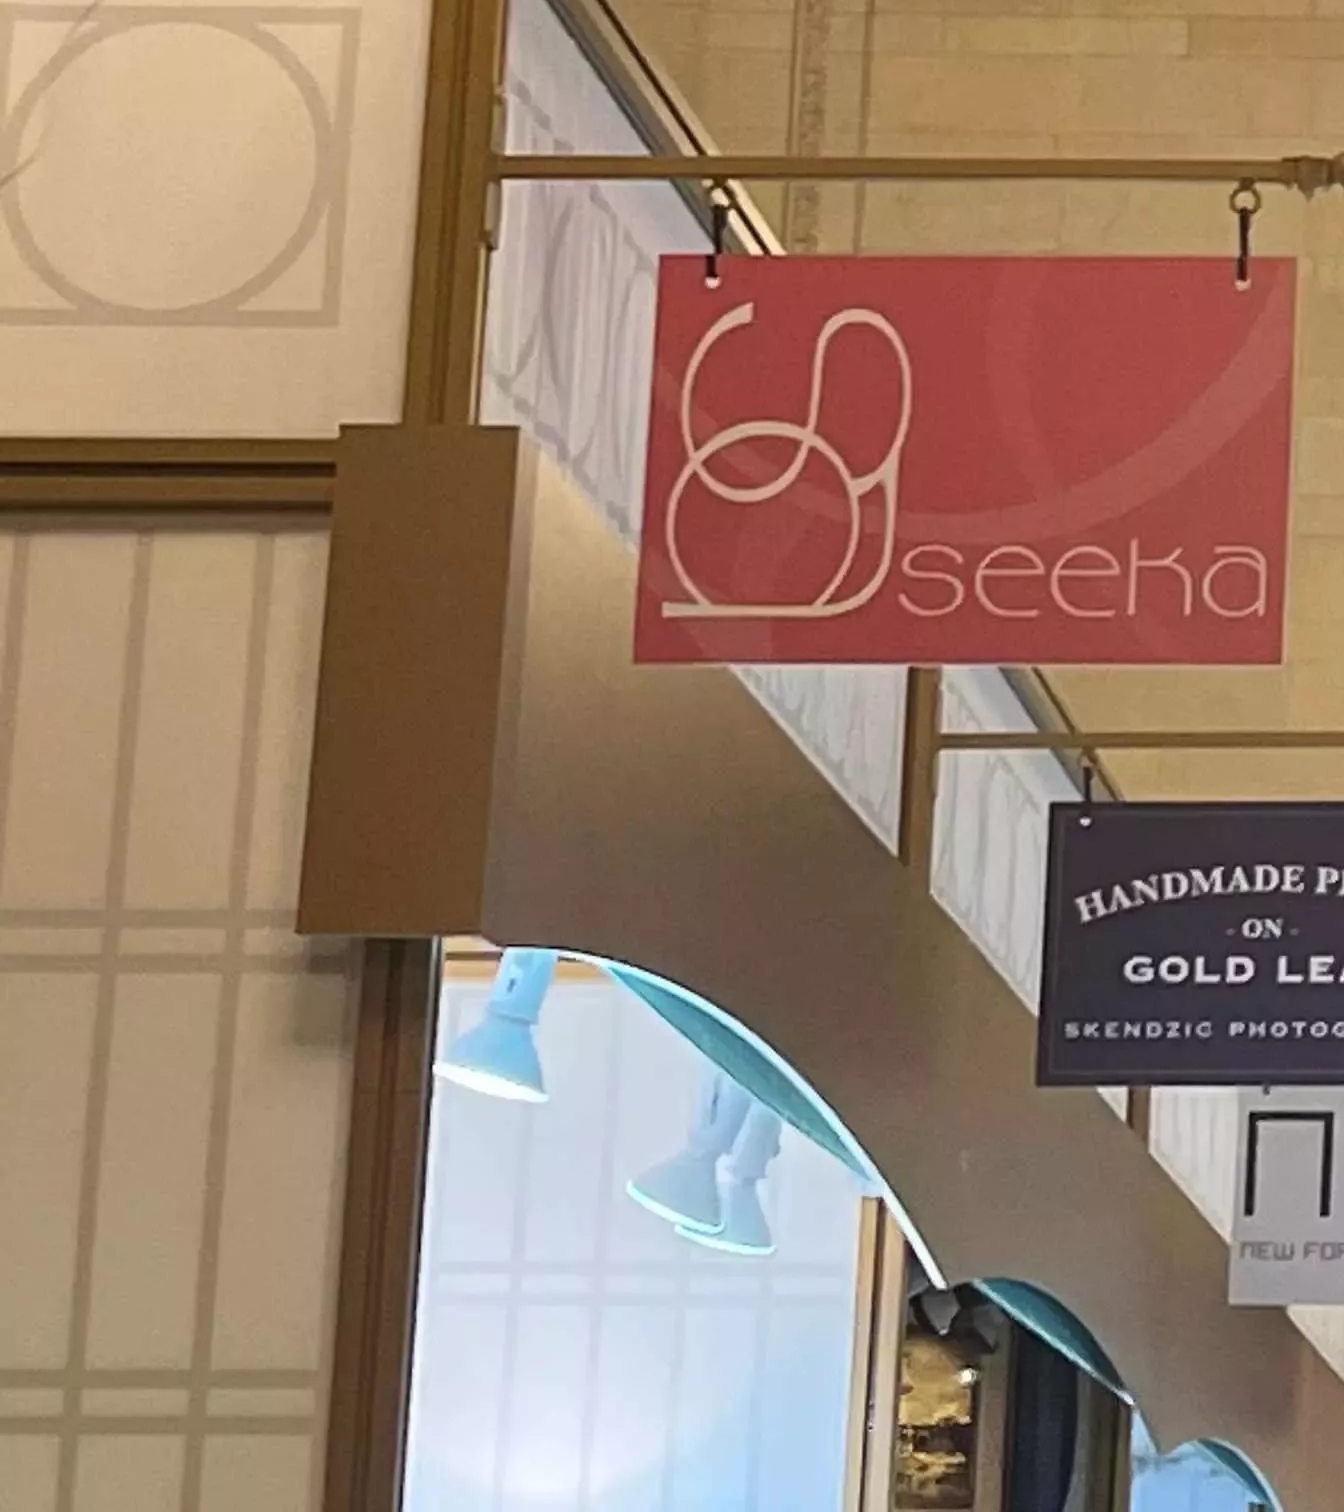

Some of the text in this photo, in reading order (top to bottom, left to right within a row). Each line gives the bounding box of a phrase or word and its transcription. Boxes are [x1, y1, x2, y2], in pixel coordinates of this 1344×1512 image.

[898, 536, 1269, 619] seeka
[1072, 863, 1306, 925] HANDMADE
[1240, 917, 1285, 940] ON
[1122, 954, 1256, 984] GOLD
[1238, 1240, 1295, 1262] NEW
